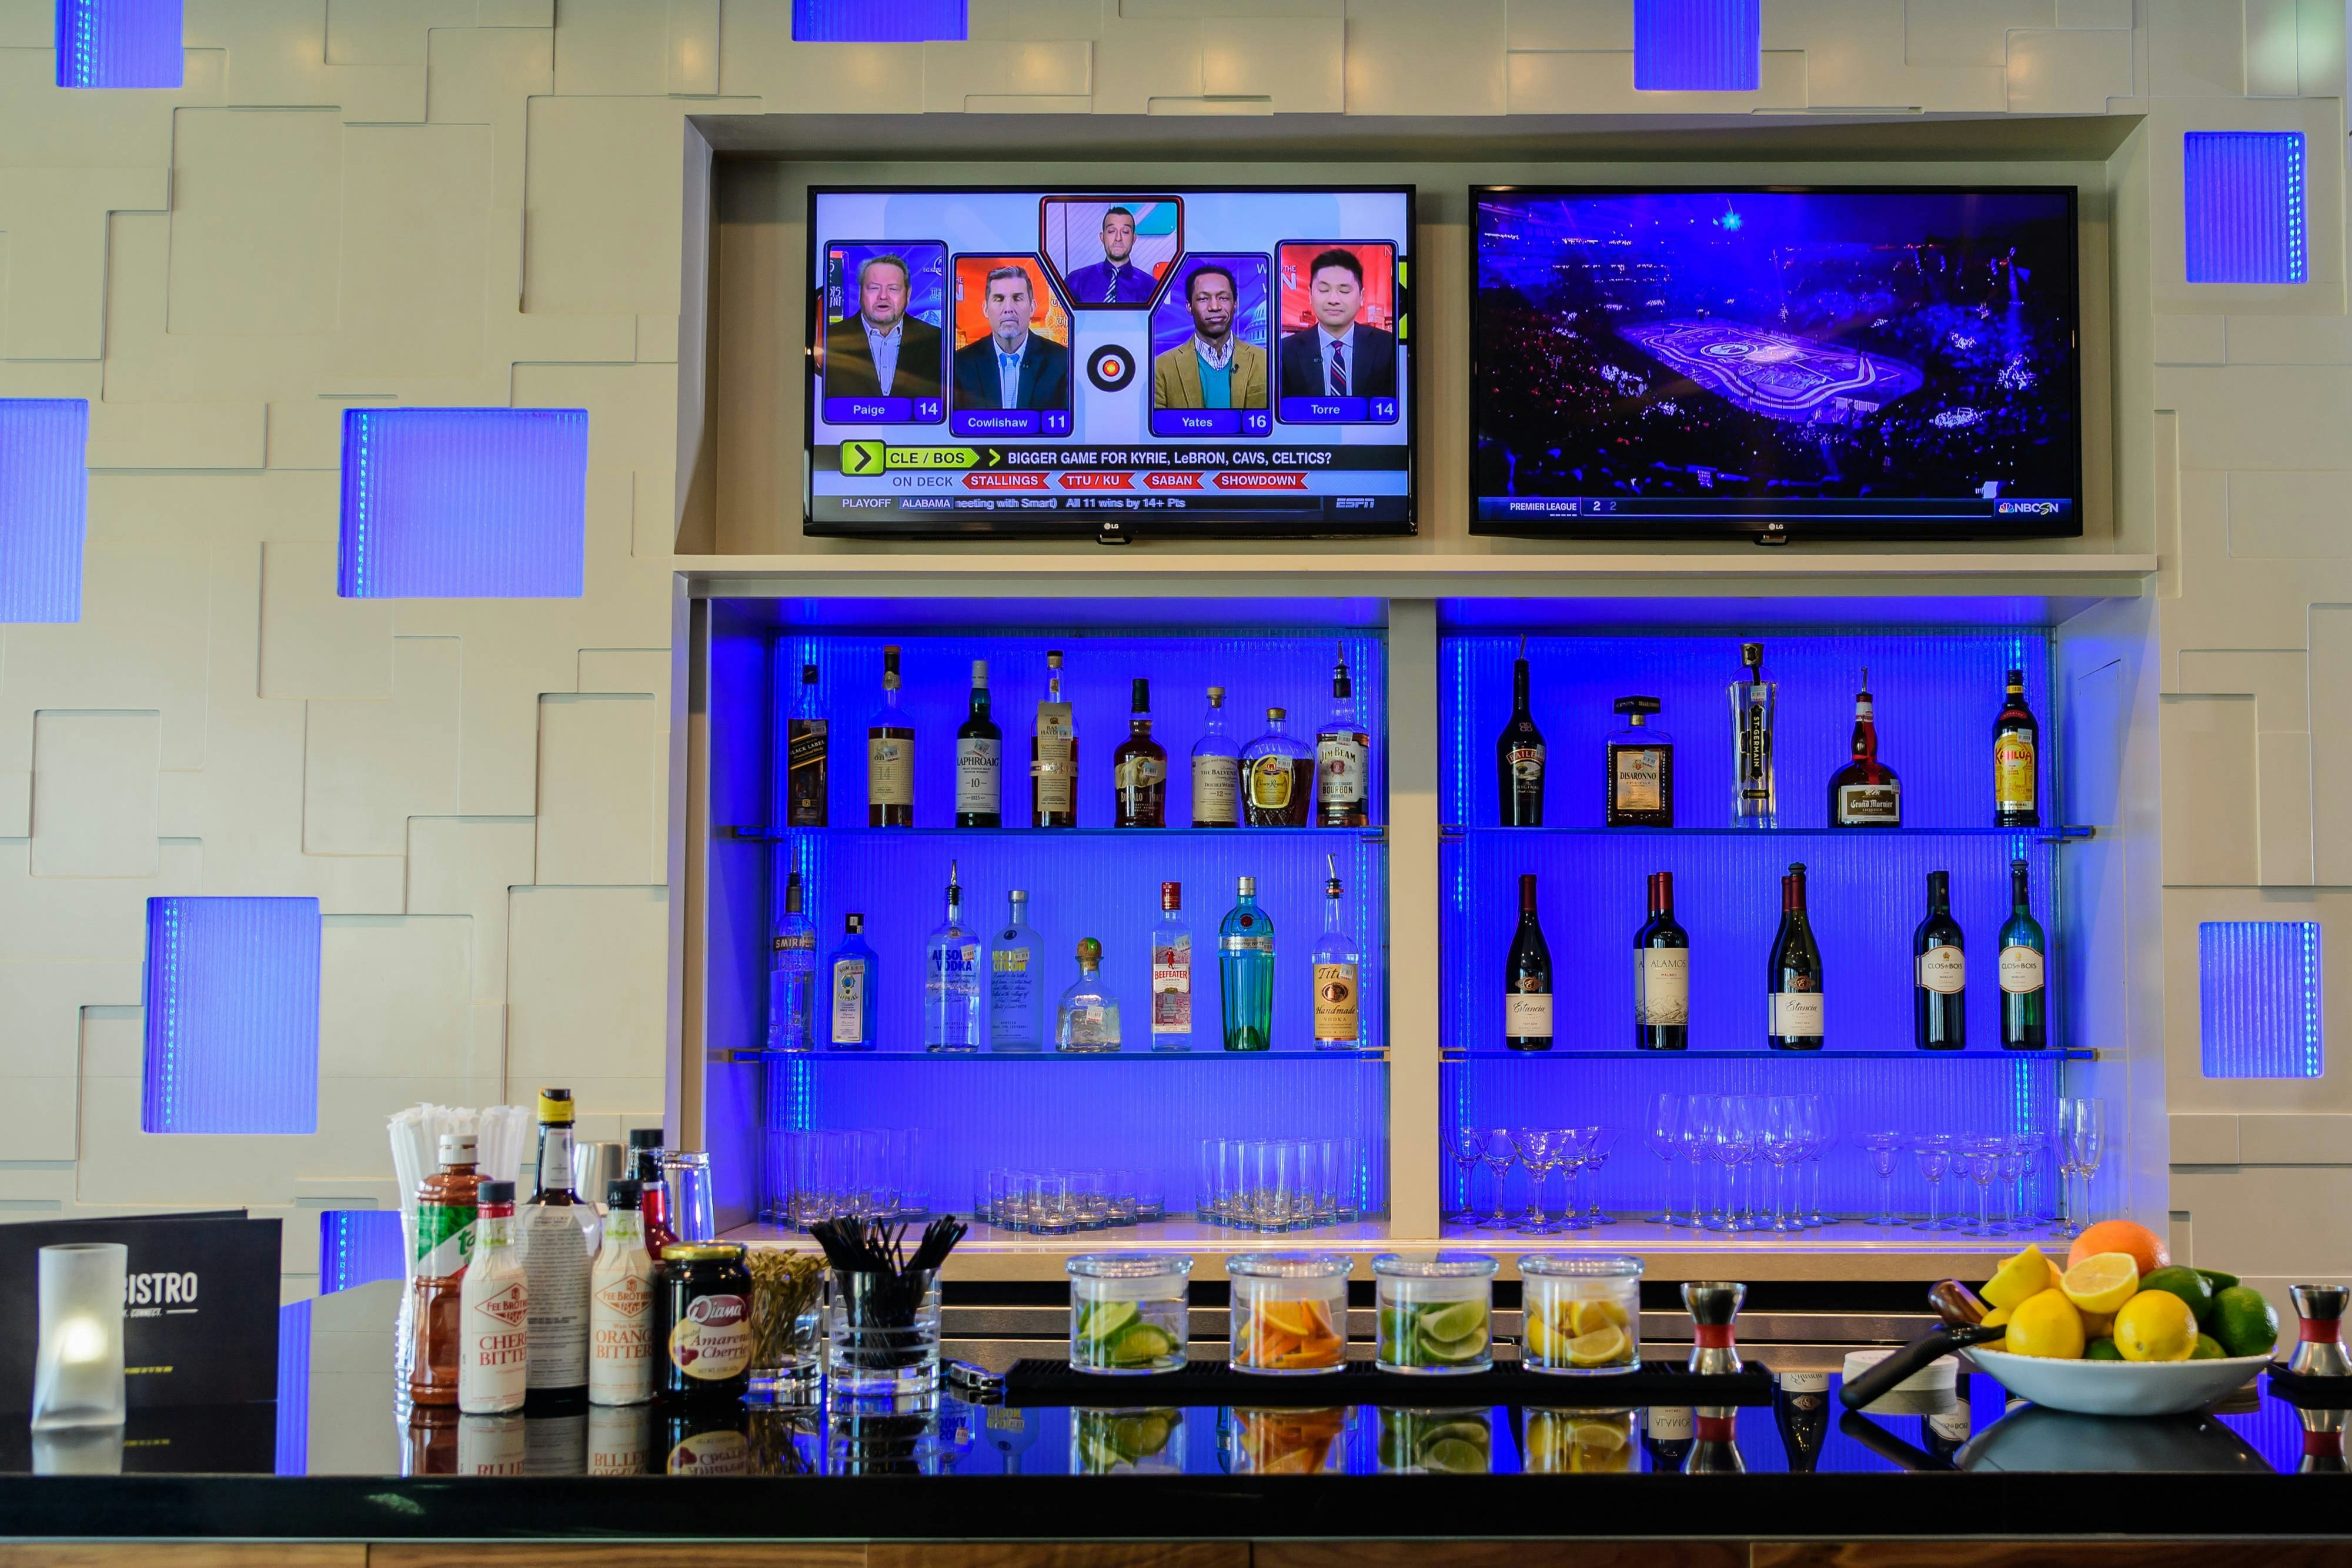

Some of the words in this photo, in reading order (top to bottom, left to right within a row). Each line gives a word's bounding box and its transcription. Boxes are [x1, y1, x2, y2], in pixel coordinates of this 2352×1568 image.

[853, 404, 885, 417] Paige
[920, 403, 938, 415] 14
[1311, 404, 1340, 415] Torre
[1376, 403, 1394, 415] 14
[968, 417, 1028, 428] Cowlishaw
[1048, 416, 1065, 428] 11
[1182, 417, 1212, 428] Yates
[1248, 416, 1267, 428] 16
[890, 453, 918, 464] CLE
[923, 453, 928, 464] /
[934, 452, 965, 464] BOS
[1008, 452, 1057, 464] BIGGER
[1060, 452, 1097, 464] GAME
[1101, 452, 1127, 464] FOR
[1131, 452, 1170, 466] KYRIE,
[1174, 452, 1229, 466] LeBRON,
[1232, 452, 1269, 466] CAVS,
[1272, 452, 1332, 464] CELTICS?
[893, 477, 912, 487] ON
[917, 476, 953, 487] DECK
[971, 475, 1039, 486] STALLINGS
[1067, 476, 1091, 486] TTU
[1094, 476, 1100, 486] /
[1102, 476, 1120, 486] KU
[1152, 475, 1192, 486] SABAN
[1221, 475, 1296, 486] SHOWDOWN
[842, 499, 891, 508] PLAYOFF
[902, 499, 951, 508] ALABAMA
[997, 499, 1019, 508] with
[1021, 498, 1058, 509] Smart)
[1066, 499, 1081, 508] All
[1083, 499, 1095, 508] 11
[1098, 499, 1124, 508] wins
[1126, 499, 1140, 511] by
[1142, 499, 1165, 508] 14+
[1168, 499, 1186, 508] Pts
[1336, 498, 1375, 508] ESPN
[1510, 503, 1545, 511] PREMIER
[1546, 503, 1577, 511] LEAGUE
[1593, 501, 1601, 511] 2
[1609, 502, 1617, 511] 2
[2014, 502, 2059, 515] NBCSN
[1320, 750, 1333, 764] JIM
[1335, 747, 1355, 763] BEAM
[1509, 750, 1536, 761] BAILE
[1620, 772, 1656, 781] DISARONNO
[971, 778, 980, 788] 10
[1322, 786, 1353, 794] BOURBON
[1850, 800, 1869, 808] Grand
[1870, 800, 1893, 808] Marnier
[776, 938, 812, 948] SMIRN
[936, 961, 972, 971] VODKA
[1651, 959, 1686, 968] ALAMOS
[1155, 970, 1188, 979] BEEFEATER
[1513, 1001, 1546, 1014] Estancia
[1786, 1000, 1819, 1012] Estancia
[125, 1272, 198, 1305] ISTRO
[487, 1302, 501, 1311] FEE
[686, 1295, 742, 1323] Diana
[596, 1329, 653, 1343] ORANG
[480, 1348, 527, 1366] BITTE
[597, 1344, 653, 1359] BITTER
